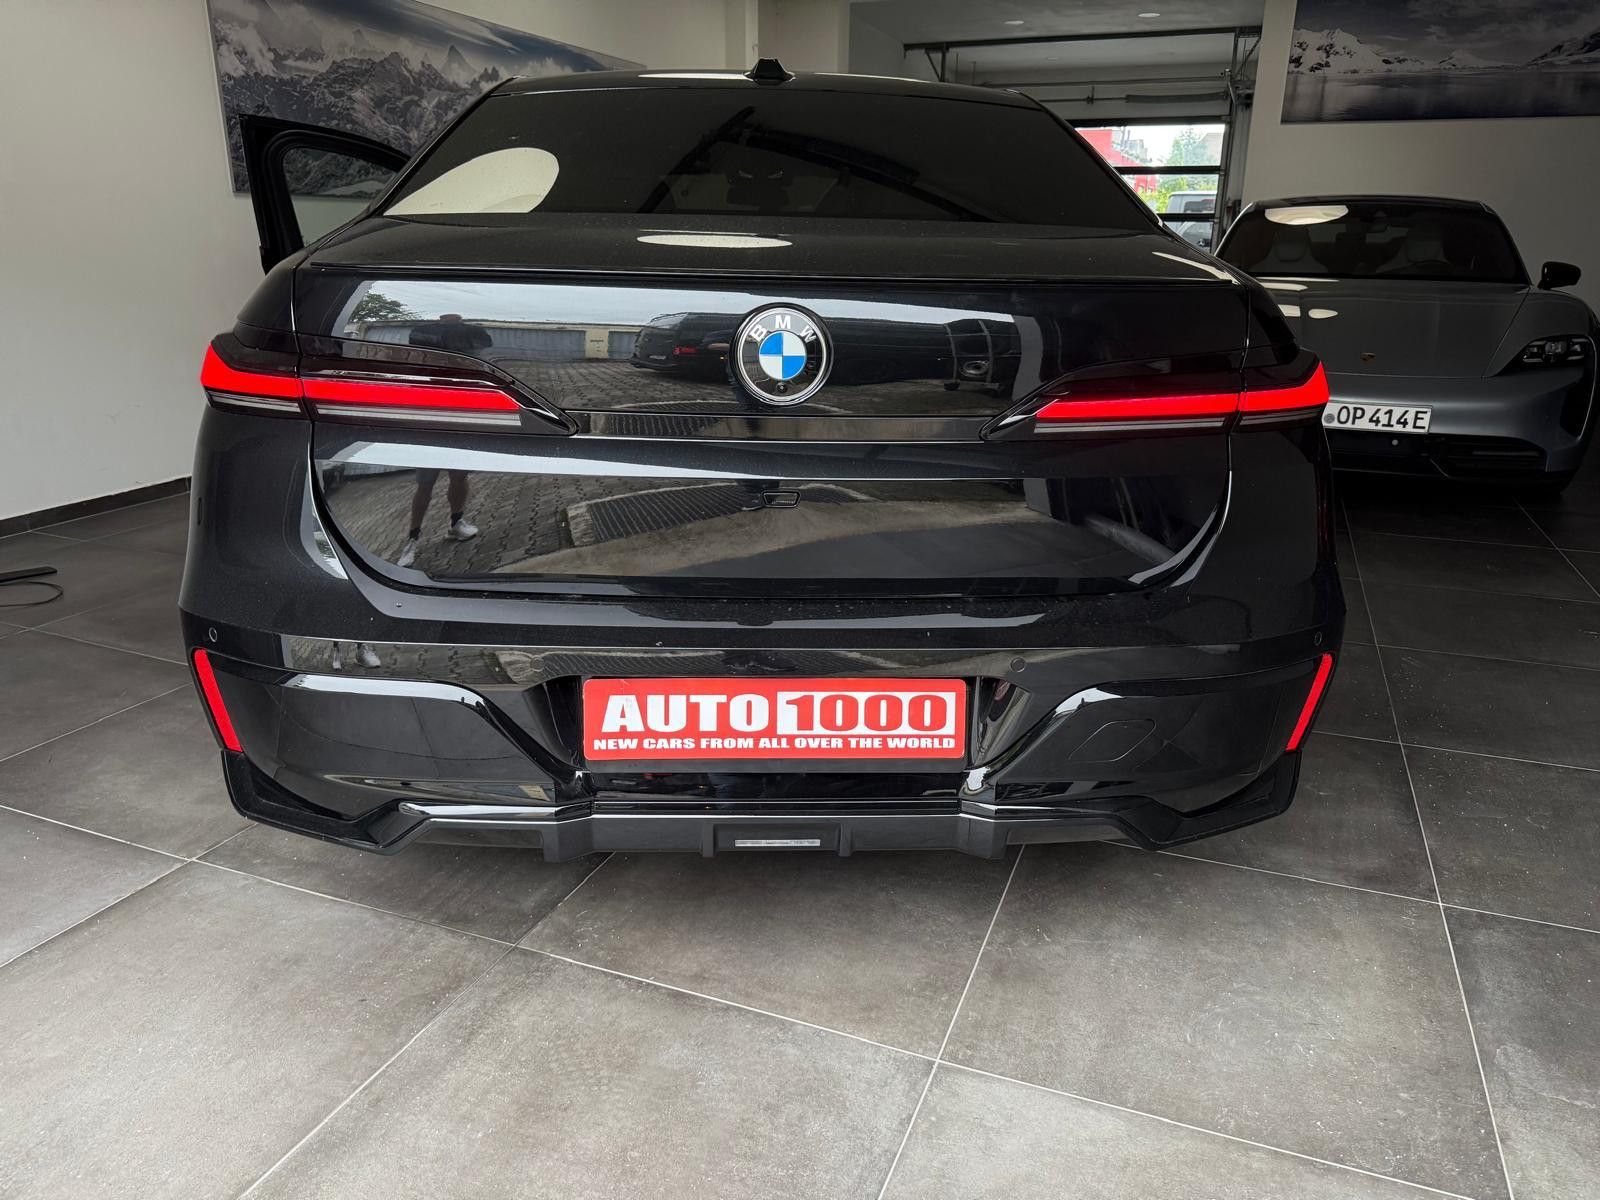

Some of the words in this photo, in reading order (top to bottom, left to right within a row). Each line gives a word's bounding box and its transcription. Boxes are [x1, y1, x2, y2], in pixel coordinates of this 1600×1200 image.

[749, 314, 817, 344] BMW
[1336, 405, 1366, 425] OP
[601, 693, 769, 733] AUTO
[785, 694, 948, 732] 1000
[593, 738, 639, 750] NEW
[642, 738, 696, 749] CARS
[700, 738, 754, 749] FROM
[758, 738, 790, 748] ALL
[794, 737, 844, 749] OVER
[848, 737, 882, 748] THE
[887, 737, 956, 749] WORLD
